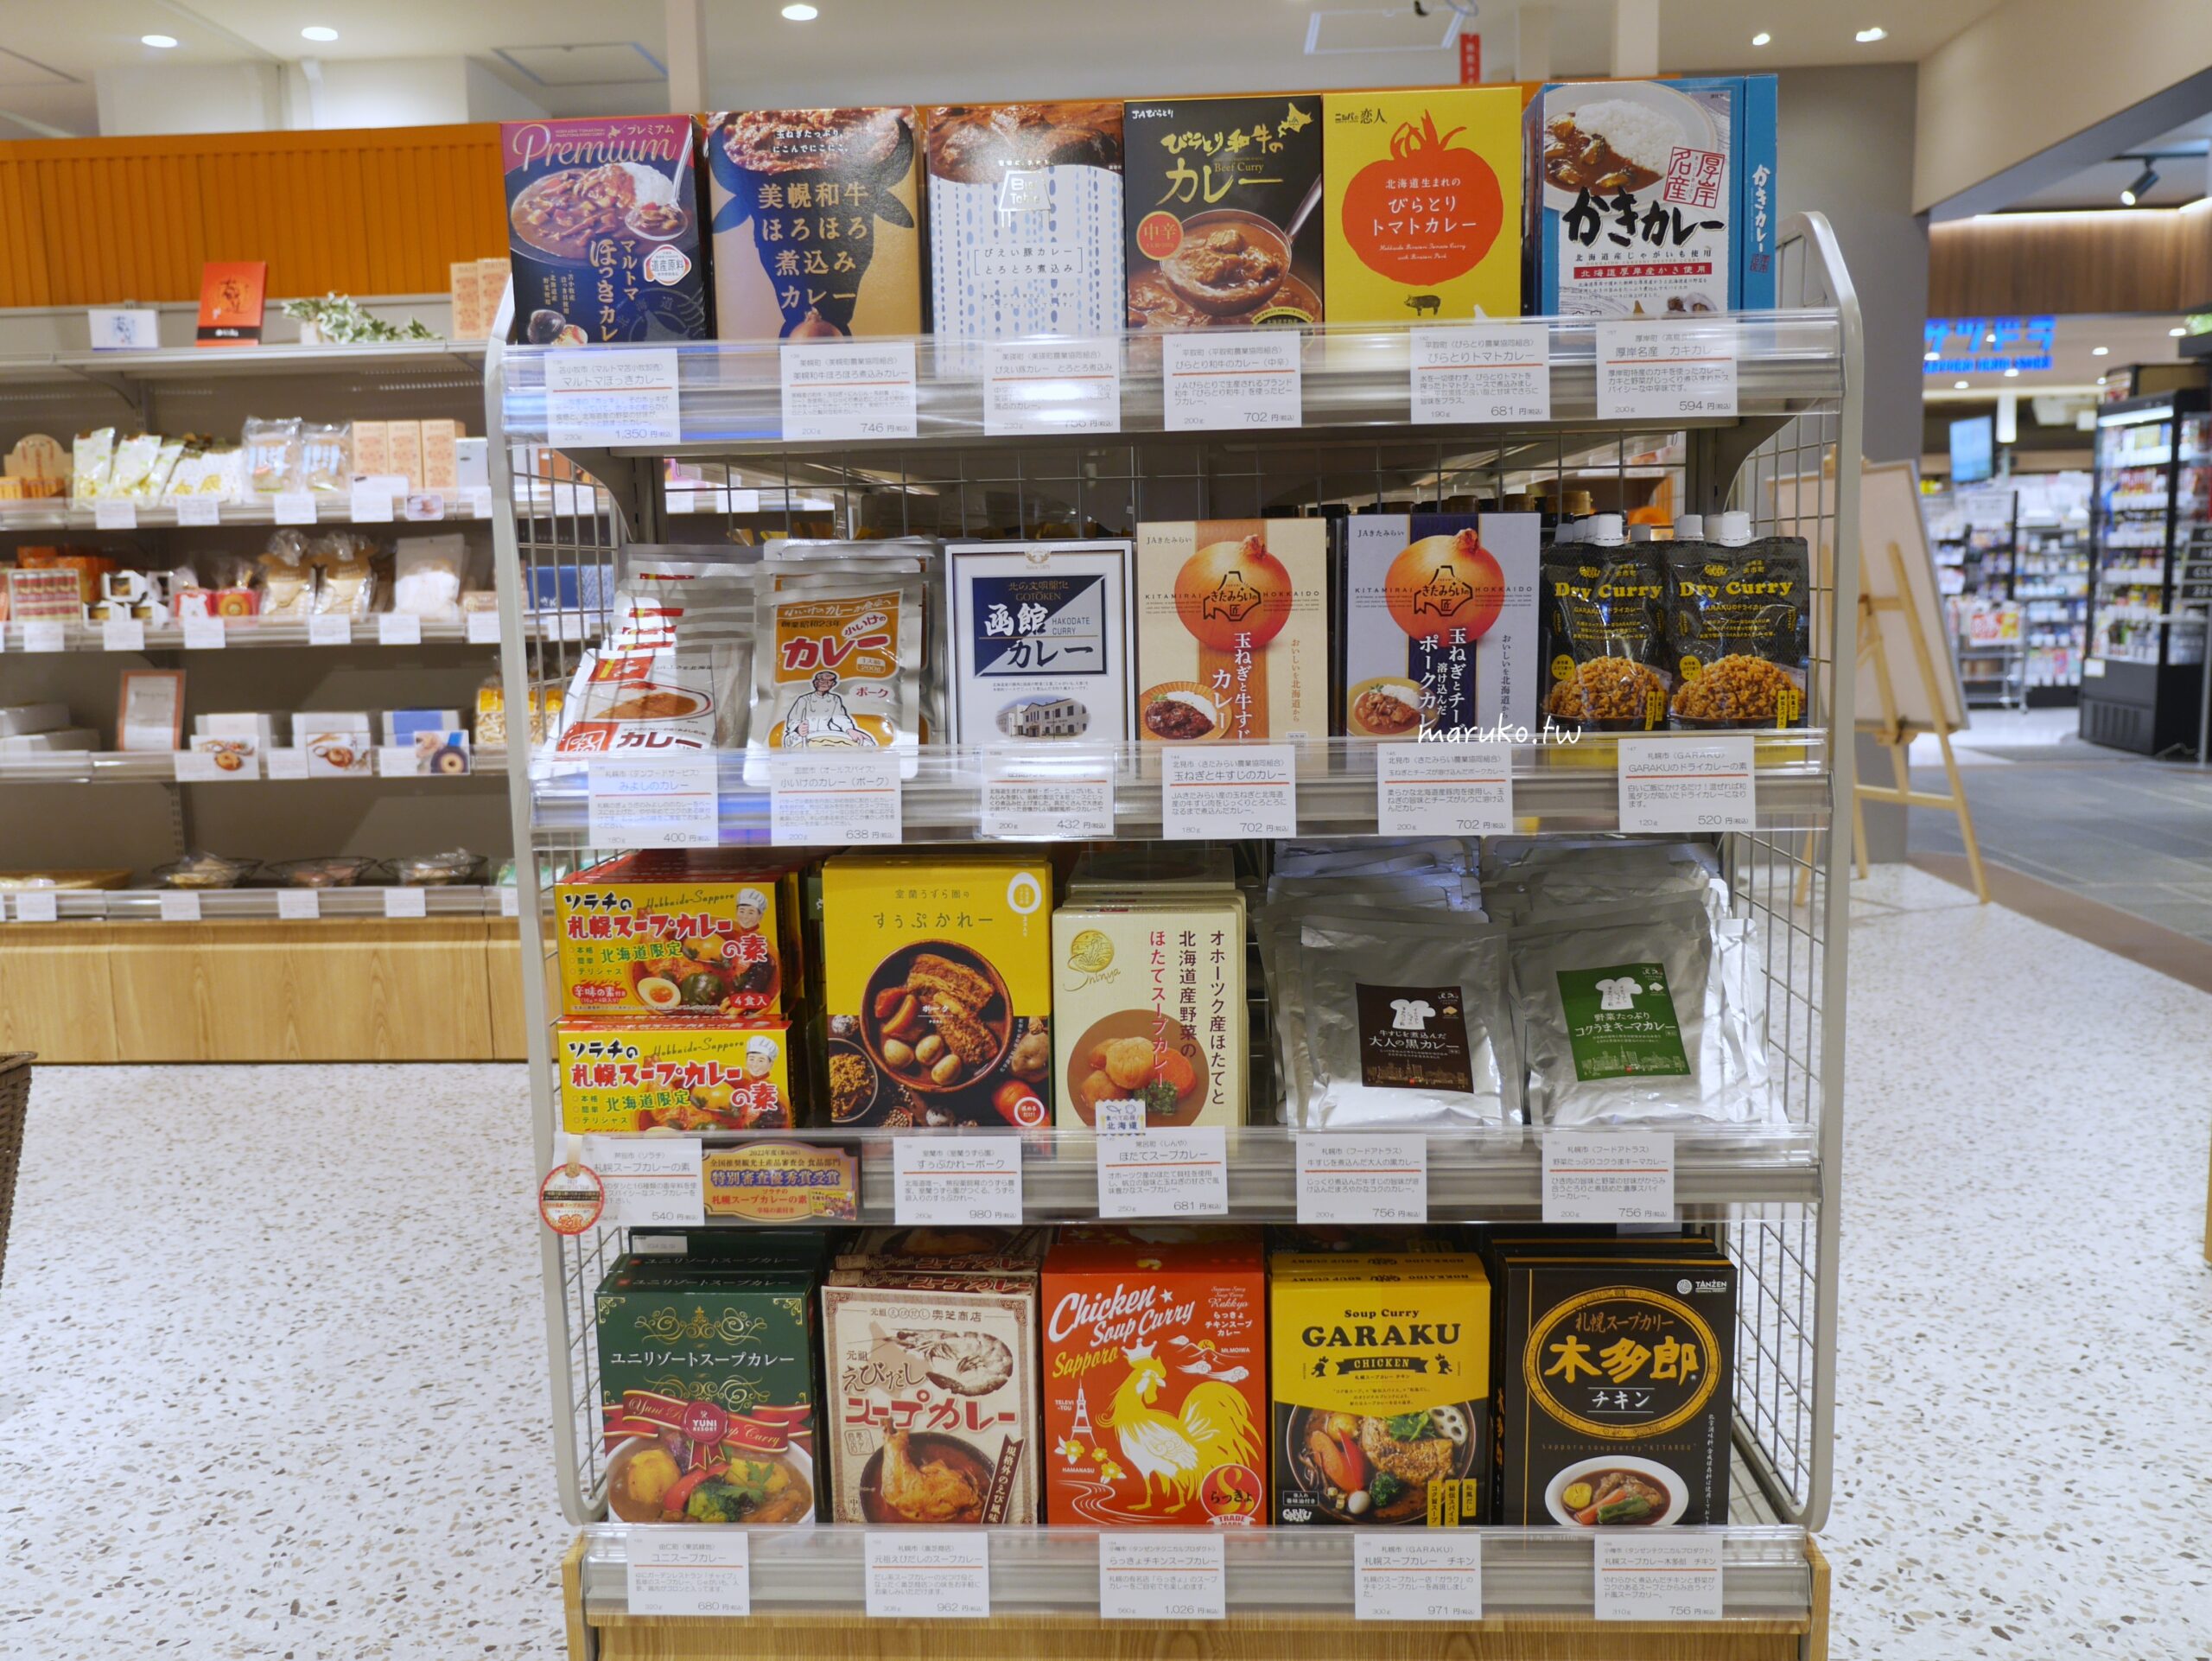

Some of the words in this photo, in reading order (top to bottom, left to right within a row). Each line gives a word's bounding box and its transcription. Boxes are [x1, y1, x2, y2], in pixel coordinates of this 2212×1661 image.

[1132, 109, 1173, 119] JAびらとり
[627, 124, 674, 136] プレミアム
[1160, 124, 1283, 156] びらとり和牛の
[512, 124, 677, 171] Premium
[1214, 162, 1235, 172] Beef
[1237, 162, 1264, 174] Curry
[1155, 157, 1283, 206] カレー
[1385, 178, 1460, 189] 北海道生まれの
[758, 182, 870, 209] 美幌和牛
[1389, 195, 1457, 213] びらとり
[1752, 164, 1770, 253] かきカレー
[1561, 186, 1727, 249] かきカレー
[762, 217, 868, 242] ほろほろ
[1144, 223, 1177, 240] 中辛
[1372, 218, 1477, 236] トマトカレー
[984, 247, 1072, 258] びえい豚カレー
[1576, 250, 1712, 262] 北海道産じゃがいも使用
[774, 251, 856, 277] 煮込み
[985, 264, 1073, 274] とろとろ煮込み
[621, 240, 639, 301] マルトマ
[1581, 266, 1706, 277] 北海道厚岸産かき使用
[781, 284, 856, 310] カレー
[1428, 351, 1535, 363] びらとりトマトカレー
[1616, 347, 1659, 357] 厚岸名産
[563, 374, 664, 386] マルトマほっきカレー
[1491, 406, 1514, 416] 681
[1680, 401, 1703, 410] 594
[1244, 412, 1268, 422] 702
[861, 423, 884, 433] 746
[615, 430, 647, 439] 1,350
[1357, 529, 1404, 538] JAきたみらい
[1147, 536, 1192, 544] JAきたみらい
[1554, 582, 1592, 602] Dry
[1598, 584, 1662, 599] Curry
[1679, 582, 1719, 597] Dry
[1726, 582, 1793, 595] Curry
[984, 602, 1048, 636] 函館
[1052, 617, 1090, 626] HAKODATE
[843, 614, 887, 637] 小いけの
[782, 635, 890, 669] カレー
[1007, 640, 1093, 668] カレー
[1501, 635, 1511, 719] おいしいを北海道から
[855, 687, 889, 697] ポーク
[1234, 632, 1252, 744] 玉ねぎと牛すじ
[1436, 662, 1448, 716] 溶け込んだ
[1212, 669, 1232, 729] カレー
[616, 731, 702, 748] カレー
[1629, 762, 1747, 772] GARAKUのドライカレーの素
[1174, 770, 1287, 780] 玉ねぎと牛すじのカレー
[619, 781, 690, 791] みよしのカレー
[1057, 820, 1079, 829] 432
[1457, 819, 1479, 829] 702
[1698, 815, 1722, 824] 520
[1239, 823, 1262, 832] 702
[664, 833, 686, 842] 400
[846, 830, 868, 839] 638
[895, 889, 969, 899] 室蘭うずら園の
[564, 892, 632, 912] ソラチの
[567, 913, 732, 940] 札幌スープカレー
[873, 912, 994, 929] すぅぷかれー
[601, 941, 683, 964] 北海道限定
[721, 933, 768, 963] の素
[577, 967, 622, 976] デリシャス
[1179, 930, 1197, 1059] 北海道産野菜の
[734, 995, 767, 1007] 4食入
[922, 1004, 950, 1013] ポーク
[1149, 931, 1168, 1088] ほたてスープカレー
[1209, 930, 1226, 1105] オホーツク産ほたてと
[1594, 1012, 1650, 1021] 野菜たっぷり
[1575, 1021, 1676, 1037] コクうまキーマカレー
[1370, 1035, 1459, 1050] 大人の黒カレー
[569, 1039, 639, 1060] ソラチの
[571, 1061, 742, 1089] 札幌スープカレー
[607, 1090, 690, 1112] 北海道限定
[731, 1081, 779, 1111] の素
[1119, 1151, 1208, 1161] ほたてスープカレー
[594, 1162, 690, 1173] 札幌スープカレーの素
[712, 1194, 807, 1205] 札幌スープカレーの素
[1174, 1201, 1195, 1210] 681
[652, 1211, 674, 1221] 540
[969, 1210, 992, 1219] 980
[1373, 1208, 1395, 1217] 756
[1618, 1208, 1641, 1217] 756
[932, 1310, 982, 1322] 奥芝商店
[1048, 1282, 1156, 1343] Chicken
[1214, 1311, 1244, 1320] らっきょ
[1344, 1309, 1376, 1319] Soup
[1381, 1308, 1420, 1319] Curry
[1090, 1319, 1136, 1346] Soup
[1137, 1301, 1195, 1336] Curry
[1205, 1320, 1253, 1329] チキンスープ
[1575, 1311, 1675, 1333] 札幌スープカリー
[1302, 1323, 1461, 1348] GARAKU
[611, 1352, 795, 1367] ユニリゾートスープカレー
[846, 1350, 868, 1361] 元祖
[1544, 1335, 1700, 1385] 木多郎
[1052, 1346, 1118, 1379] Sapporo
[1354, 1358, 1410, 1369] CHICKEN
[842, 1361, 925, 1392] えびだし
[629, 1397, 663, 1416] Yuni
[1592, 1391, 1650, 1410] チキン
[744, 1424, 782, 1448] Curry
[1210, 1489, 1253, 1504] らっきょ
[652, 1554, 726, 1562] ユニスープカレー
[1364, 1556, 1437, 1566] 札幌スープカレー
[1447, 1556, 1474, 1565] チキン
[937, 1603, 958, 1613] 962
[1165, 1605, 1194, 1614] 1,026
[1427, 1606, 1448, 1614] 971
